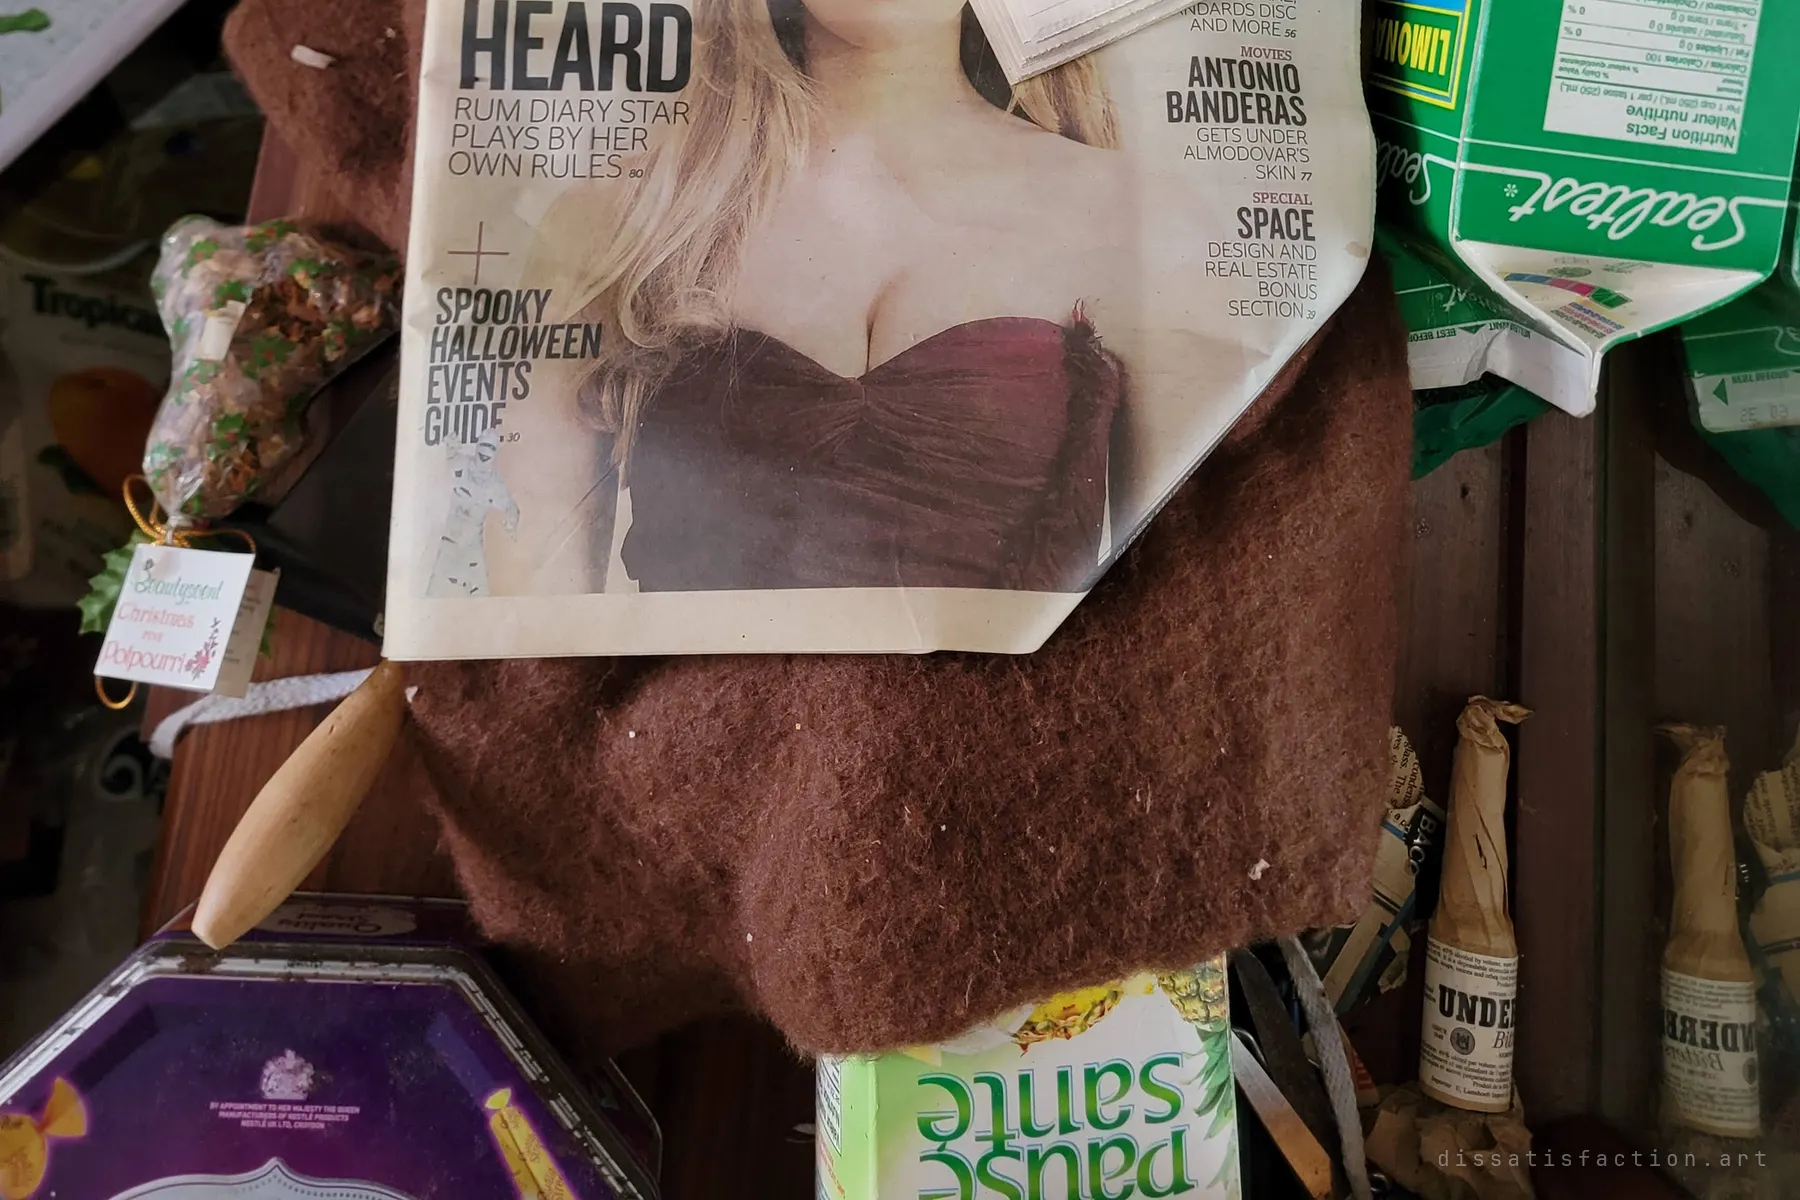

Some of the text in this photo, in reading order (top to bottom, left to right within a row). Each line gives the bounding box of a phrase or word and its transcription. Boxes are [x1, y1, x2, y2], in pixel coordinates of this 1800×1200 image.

[1259, 4, 1297, 20] DISC
[1190, 18, 1297, 38] AND MORE 56
[459, 0, 693, 93] HEARD
[1240, 46, 1292, 61] MOVIES
[1645, 53, 1662, 62] 100
[1188, 56, 1301, 94] ANTONIO
[454, 97, 690, 125] RUM DIARY STAR
[1166, 91, 1307, 126] BANDERAS
[1625, 104, 1737, 131] Valeur nutritive
[451, 124, 649, 151] PLAYS BY HER
[1196, 127, 1308, 145] GETS UNDER
[1625, 122, 1736, 148] Nutrition Facts
[448, 151, 644, 179] OWN RULES 80
[1183, 145, 1310, 163] ALMODOVAR'S
[1255, 165, 1313, 181] SKIN 77
[1252, 192, 1313, 206] SPECIAL
[1508, 174, 1745, 251] Sealtest
[1236, 206, 1316, 241] SPACE
[1207, 241, 1317, 261] DESIGN AND
[1205, 261, 1318, 281] REAL ESTATE
[1258, 281, 1318, 299] BONUS
[436, 287, 552, 325] SPOOKY
[1228, 300, 1316, 320] SECTION 39
[430, 323, 602, 364] HALLOWEEN
[1436, 328, 1456, 338] BEST
[427, 360, 532, 405] EVENTS
[424, 402, 521, 446] GUIDE 30
[117, 601, 195, 628] Christmas
[103, 640, 186, 673] Potpourri
[916, 1052, 1184, 1148] santé
[919, 1124, 1199, 1200] pause
